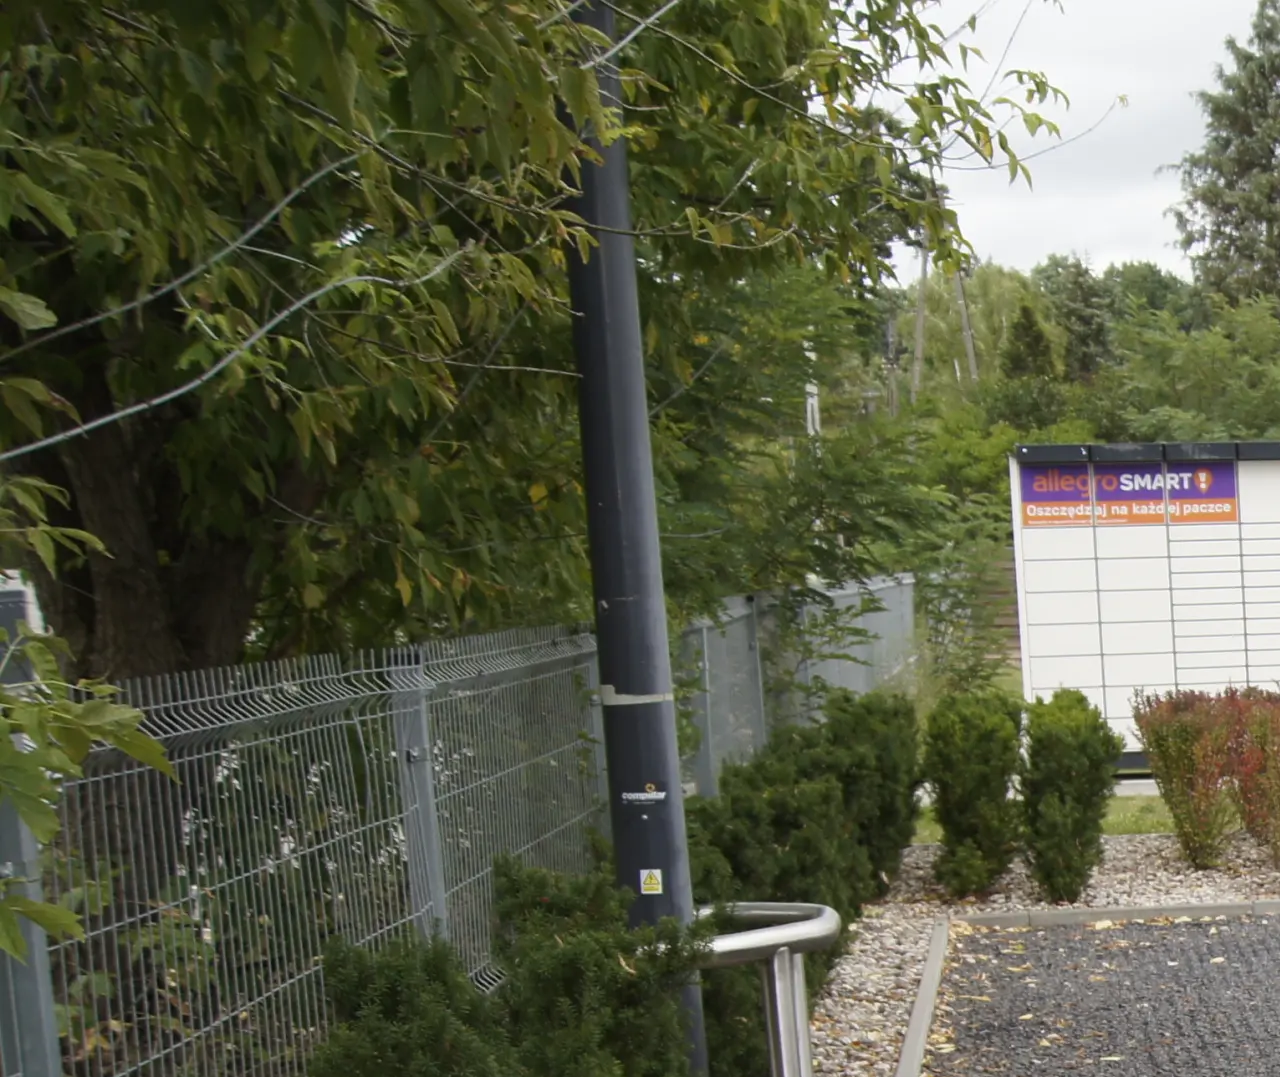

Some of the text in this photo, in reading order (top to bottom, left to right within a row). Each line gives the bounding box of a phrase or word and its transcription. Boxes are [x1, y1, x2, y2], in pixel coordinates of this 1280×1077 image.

[1111, 505, 1128, 515] na
[1132, 502, 1180, 516] każdej
[1183, 503, 1231, 516] paczce
